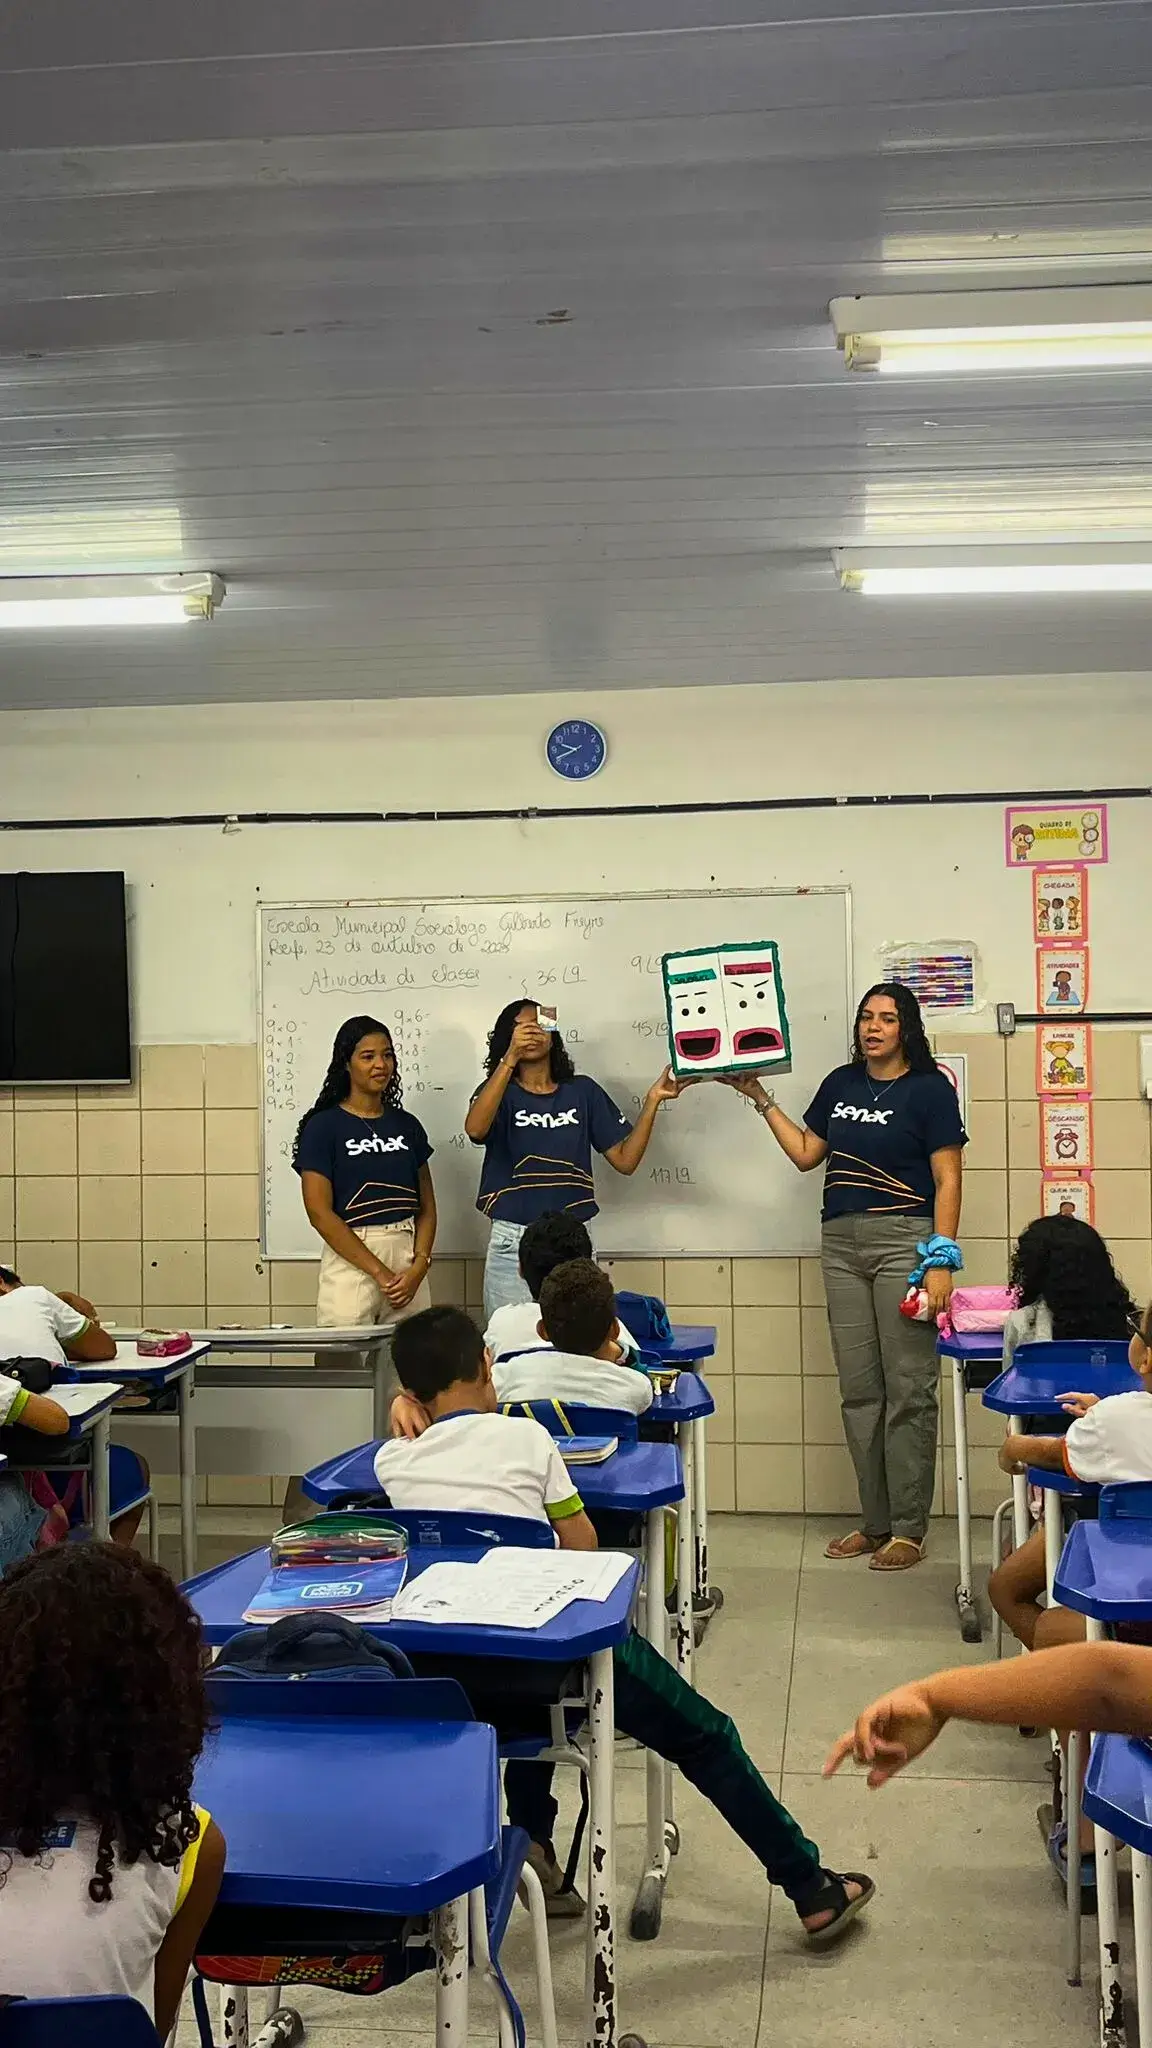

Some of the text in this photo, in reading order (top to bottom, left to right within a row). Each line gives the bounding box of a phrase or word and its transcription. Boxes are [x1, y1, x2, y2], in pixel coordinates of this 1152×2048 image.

[571, 725, 580, 733] 12
[315, 940, 336, 956] 23
[345, 938, 361, 953] de
[396, 967, 415, 986] de
